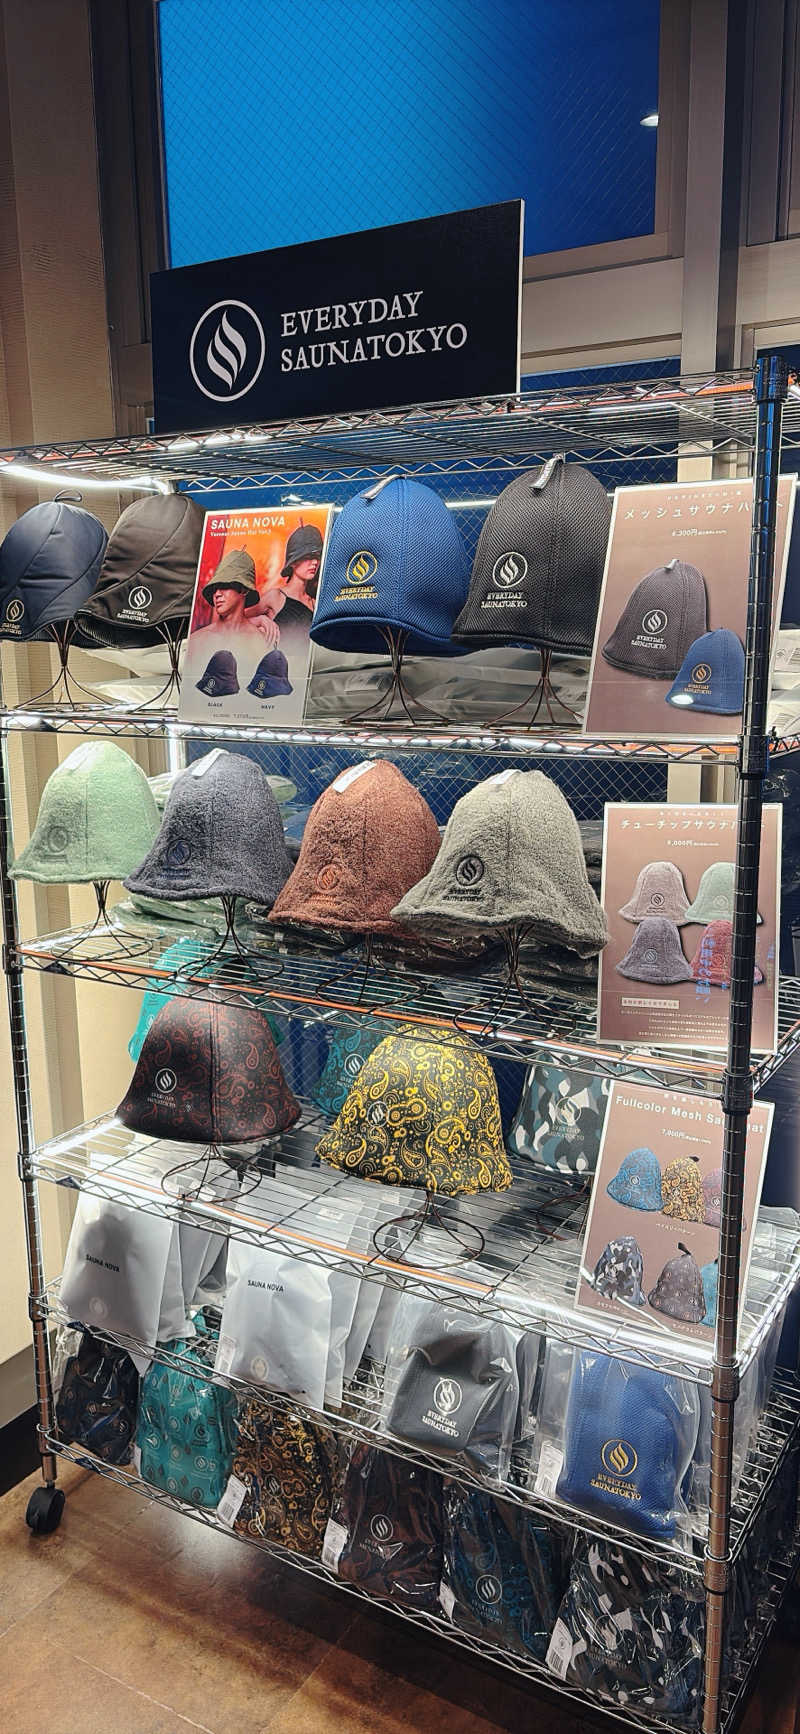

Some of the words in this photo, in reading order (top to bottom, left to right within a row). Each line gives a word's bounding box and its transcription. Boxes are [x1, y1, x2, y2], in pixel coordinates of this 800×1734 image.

[281, 291, 423, 337] EVERYDAY
[281, 322, 468, 372] SAUNATOKYO
[211, 518, 248, 530] SAUNA
[252, 516, 285, 528] NOVA
[486, 591, 524, 601] EVERYDAY
[616, 1095, 667, 1114] Fullcolor
[671, 1107, 702, 1122] Mesh
[86, 1254, 104, 1266] SAUNA
[104, 1261, 120, 1273] NOVA
[247, 1279, 266, 1289] SAUNA
[266, 1282, 284, 1292] NOVA
